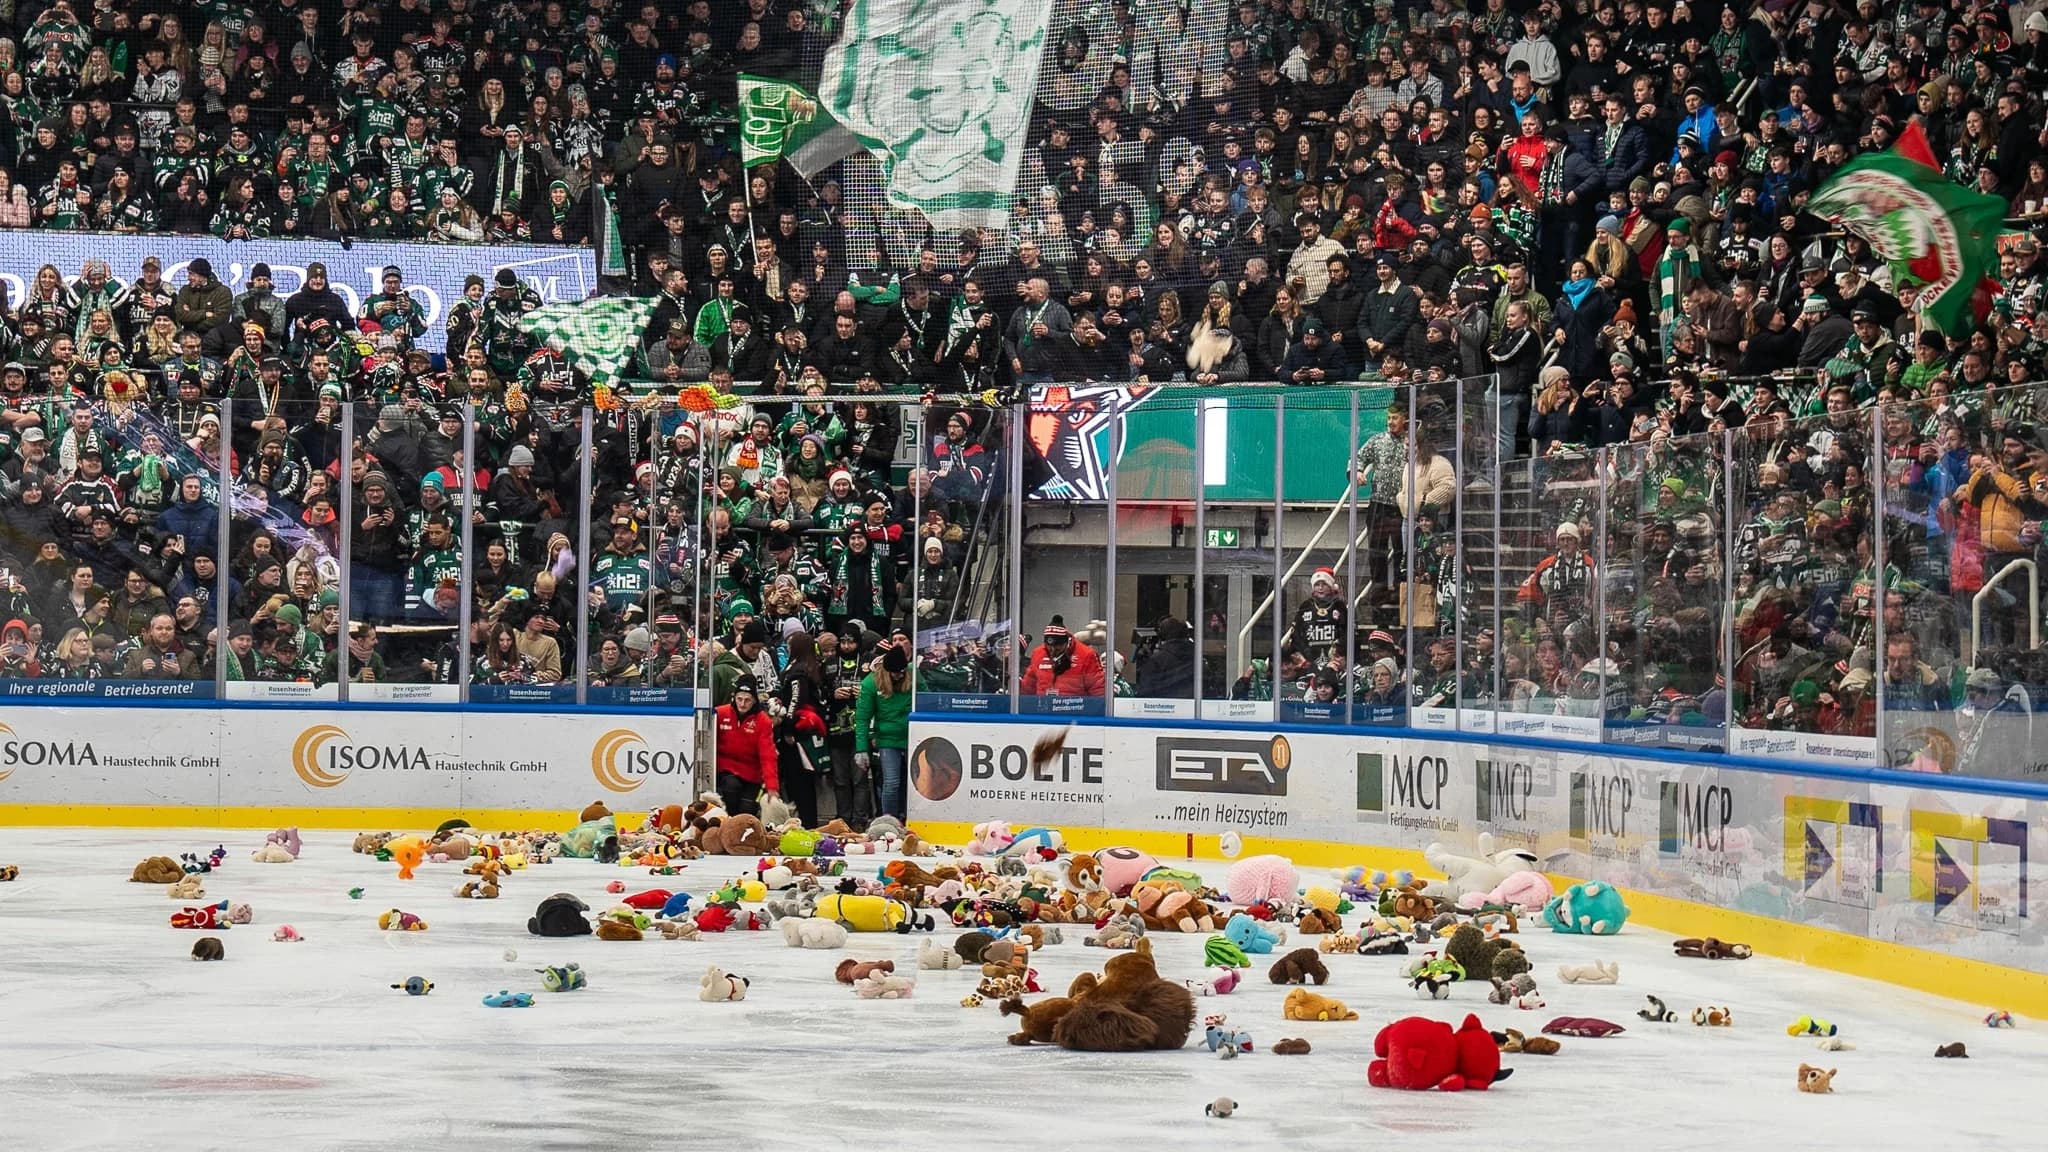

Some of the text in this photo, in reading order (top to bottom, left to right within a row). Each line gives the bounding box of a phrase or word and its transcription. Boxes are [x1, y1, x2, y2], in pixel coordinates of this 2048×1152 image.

[9, 680, 194, 697] Ihre regionale Betriebsrente!
[4, 741, 220, 768] SOMA Haustechnik GmbH
[329, 744, 547, 773] ISOMA Haustechnik GmbH
[970, 744, 1104, 784] BOLTE
[1170, 749, 1276, 784] ETA
[970, 789, 1104, 804] MODERNE HEIZTECHNIK
[1390, 754, 1449, 810] MCP
[1494, 761, 1533, 821] MCP
[1215, 803, 1288, 829] Heizsystem
[1589, 774, 1633, 838] MCP
[1682, 781, 1733, 853] MCP
[1441, 818, 1459, 833] GmbH
